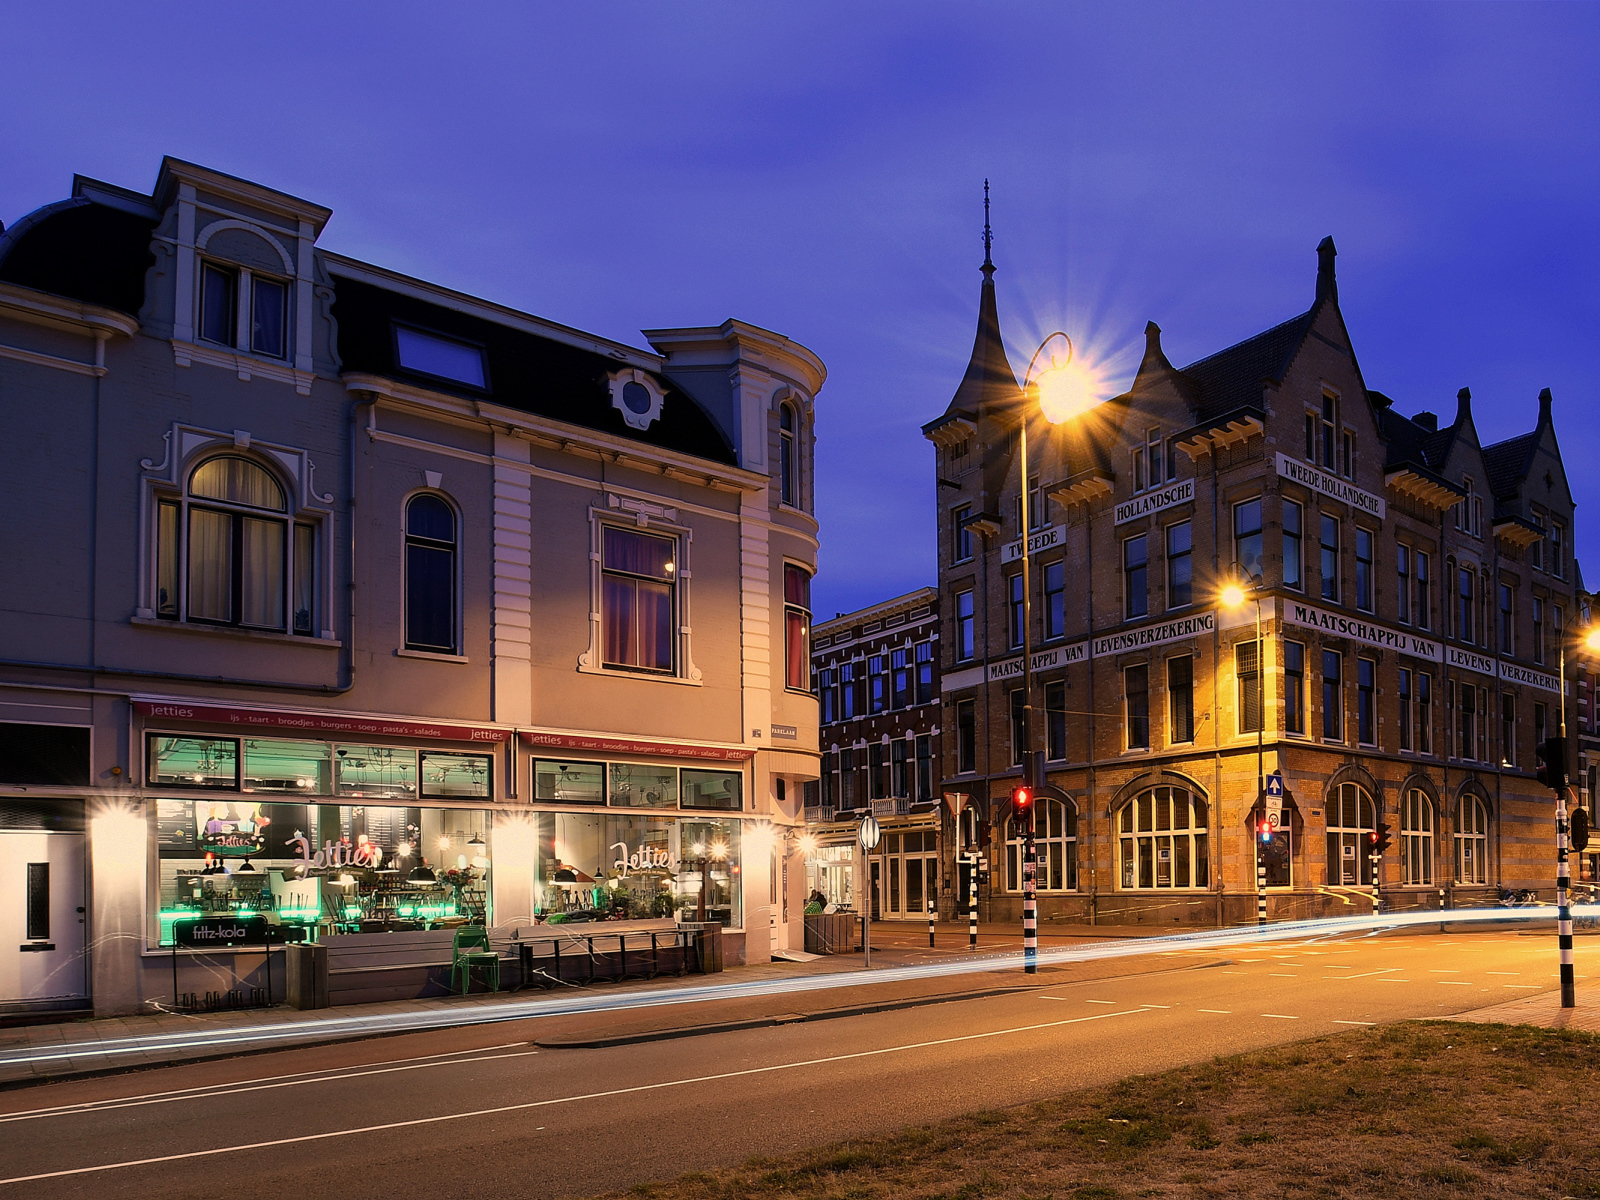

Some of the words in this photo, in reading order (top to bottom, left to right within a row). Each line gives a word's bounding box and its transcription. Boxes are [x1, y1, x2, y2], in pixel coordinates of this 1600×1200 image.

[1283, 459, 1320, 488] TWEEDE
[1321, 476, 1379, 513] HOLLANDSCHE
[1117, 483, 1192, 521] HOLLANDSCHE
[1094, 615, 1214, 655] LEVENSVERZEKERING
[1294, 605, 1407, 649] MAATSCHAPPIJ
[1412, 638, 1435, 657] VAN
[990, 651, 1058, 679] MAATSCAPPIJ
[1065, 644, 1084, 661] VAN
[1450, 649, 1492, 672] LEVENS
[150, 704, 194, 718] jetties
[230, 714, 240, 722] ijs
[278, 717, 315, 727] broodjes
[320, 720, 352, 730] burgers
[358, 724, 377, 732] soep
[383, 726, 408, 735] pasta's
[414, 728, 441, 737] salades
[470, 728, 503, 741] jetties
[531, 734, 562, 745] jetties
[568, 739, 576, 747] ijs
[603, 742, 629, 751] broodjes
[633, 744, 656, 753] burgers
[660, 746, 674, 754] soep
[700, 749, 721, 758] salades
[284, 837, 377, 881] Jetties
[609, 842, 676, 880] Jetties
[193, 924, 246, 939] fritz-kola
